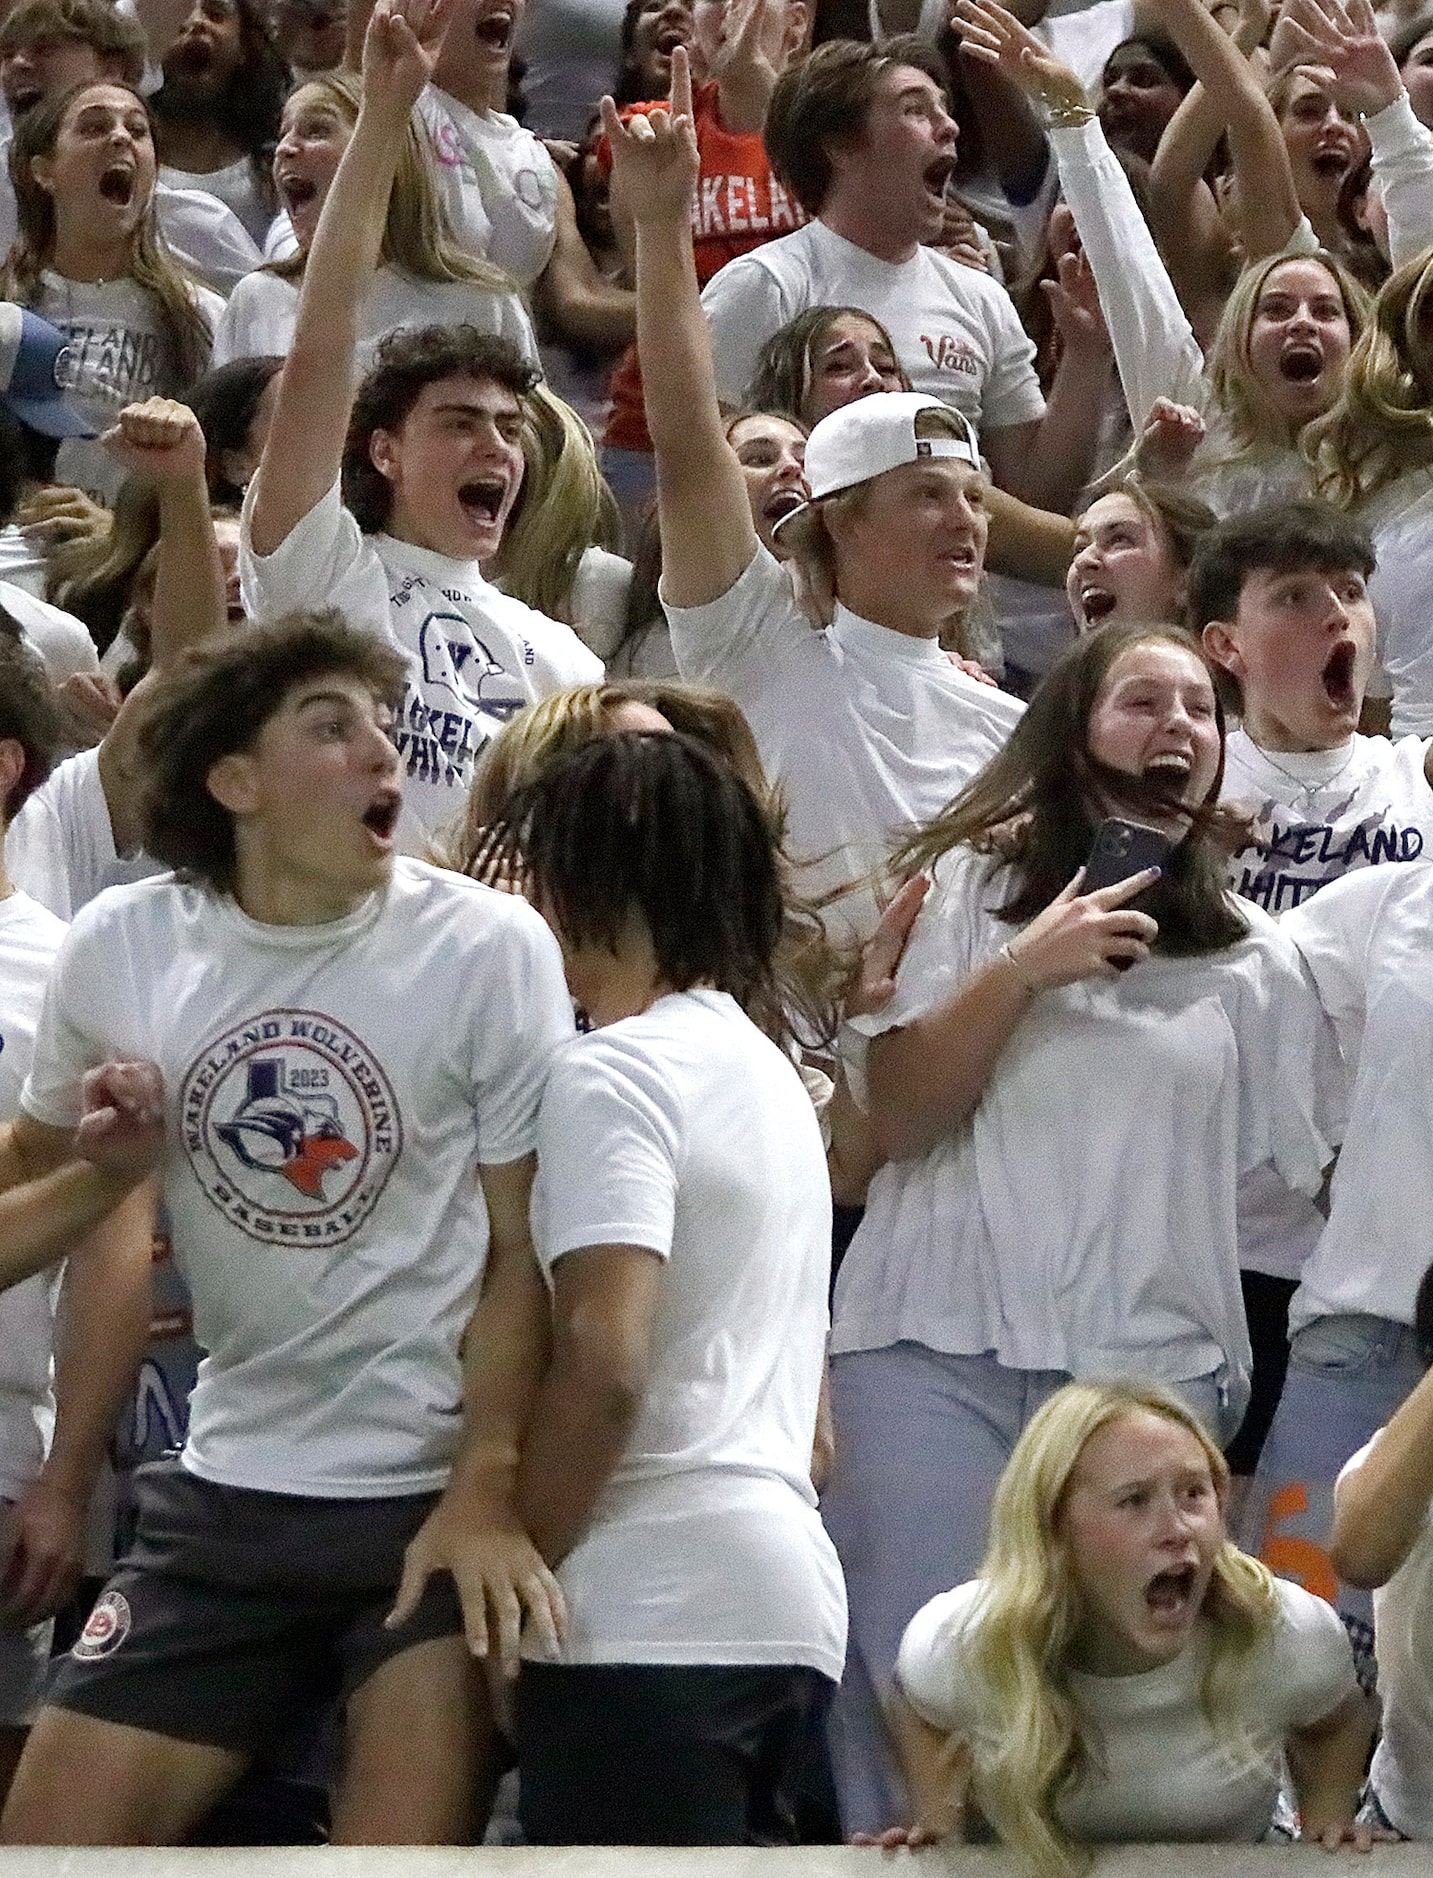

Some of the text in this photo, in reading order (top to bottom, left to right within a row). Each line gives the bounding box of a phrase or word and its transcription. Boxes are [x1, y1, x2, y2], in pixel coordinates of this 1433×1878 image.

[920, 335, 977, 376] Vans
[183, 1020, 282, 1153] WAKELAND
[290, 1067, 329, 1088] 2023
[290, 1019, 392, 1154] WOLVERINE
